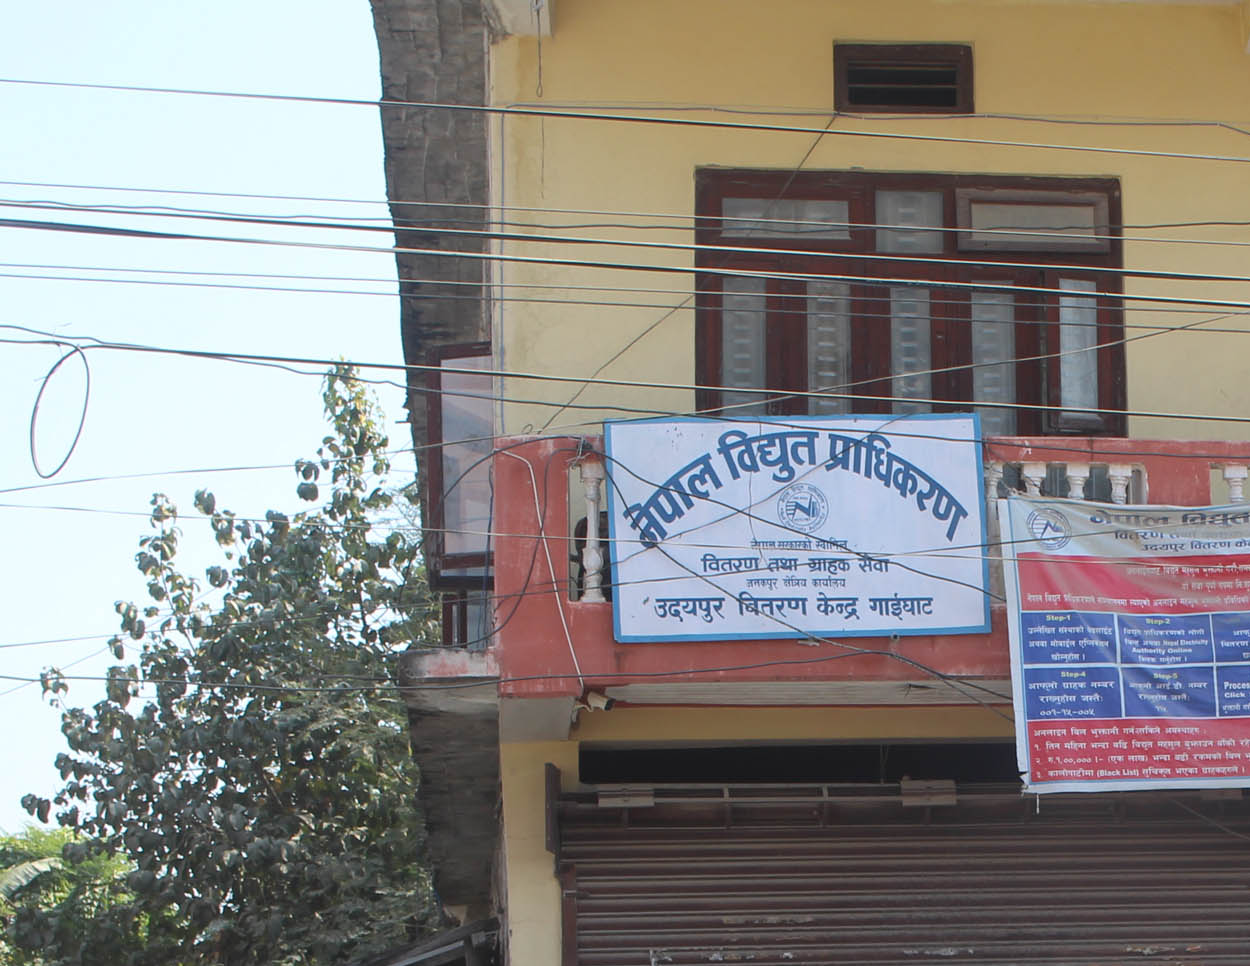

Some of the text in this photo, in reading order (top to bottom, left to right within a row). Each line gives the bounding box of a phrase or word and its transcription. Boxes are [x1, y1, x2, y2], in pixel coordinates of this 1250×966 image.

[623, 453, 723, 548] नेपाल
[717, 430, 819, 483] विद्युत
[825, 433, 968, 541] प्राधिकरण
[1142, 542, 1185, 553] उदयपुर
[1190, 540, 1231, 551] वितरण
[700, 553, 760, 573] वितरण
[767, 557, 799, 573] तथा
[808, 557, 850, 575] ग्राहक
[654, 597, 725, 622] उदयपुर
[737, 591, 808, 618] वितरण
[816, 592, 860, 620] केन्द्र
[1045, 614, 1071, 622] Step-1
[1145, 618, 1171, 626] Step-2
[1060, 671, 1087, 679] Step-4
[1224, 691, 1246, 699] Click
[1096, 768, 1121, 777] (Black
[1122, 768, 1140, 777] List)
